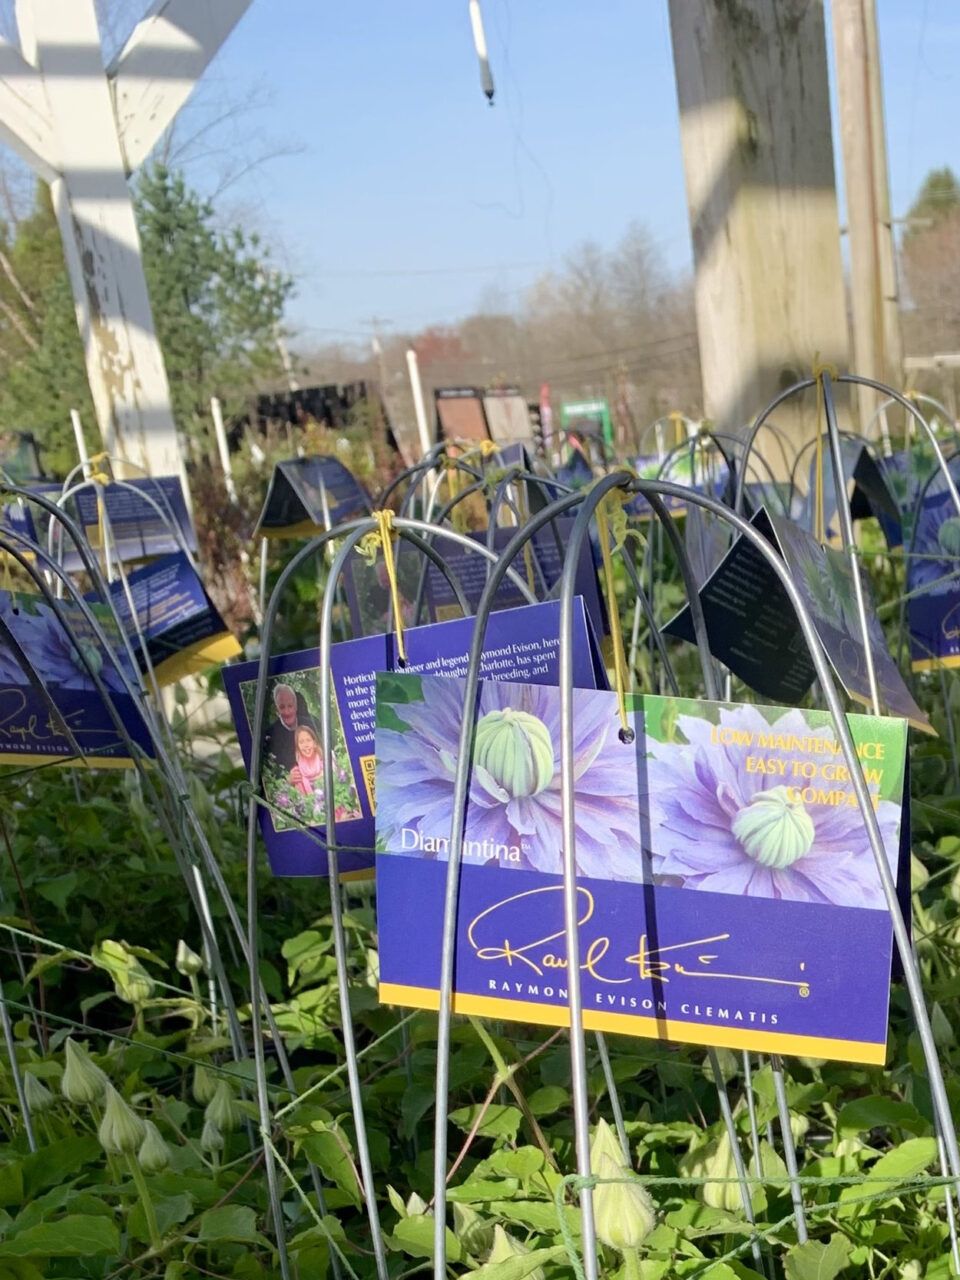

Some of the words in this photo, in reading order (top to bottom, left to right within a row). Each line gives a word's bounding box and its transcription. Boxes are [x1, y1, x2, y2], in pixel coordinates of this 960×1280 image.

[425, 658, 441, 670] and
[513, 641, 542, 654] Evison,
[479, 658, 516, 672] harlotte,
[516, 655, 532, 666] has
[532, 650, 557, 664] spent
[532, 663, 549, 676] and
[345, 688, 354, 697] in
[356, 685, 369, 695] the
[348, 698, 370, 709] more
[352, 720, 370, 732] This
[709, 724, 754, 747] LOW
[746, 756, 788, 776] EASY
[791, 760, 817, 778] TO
[786, 785, 882, 811] COMPAT
[489, 979, 569, 999] RAYMON
[595, 992, 667, 1011] EVISON
[681, 1003, 779, 1024] CLEMATIS
